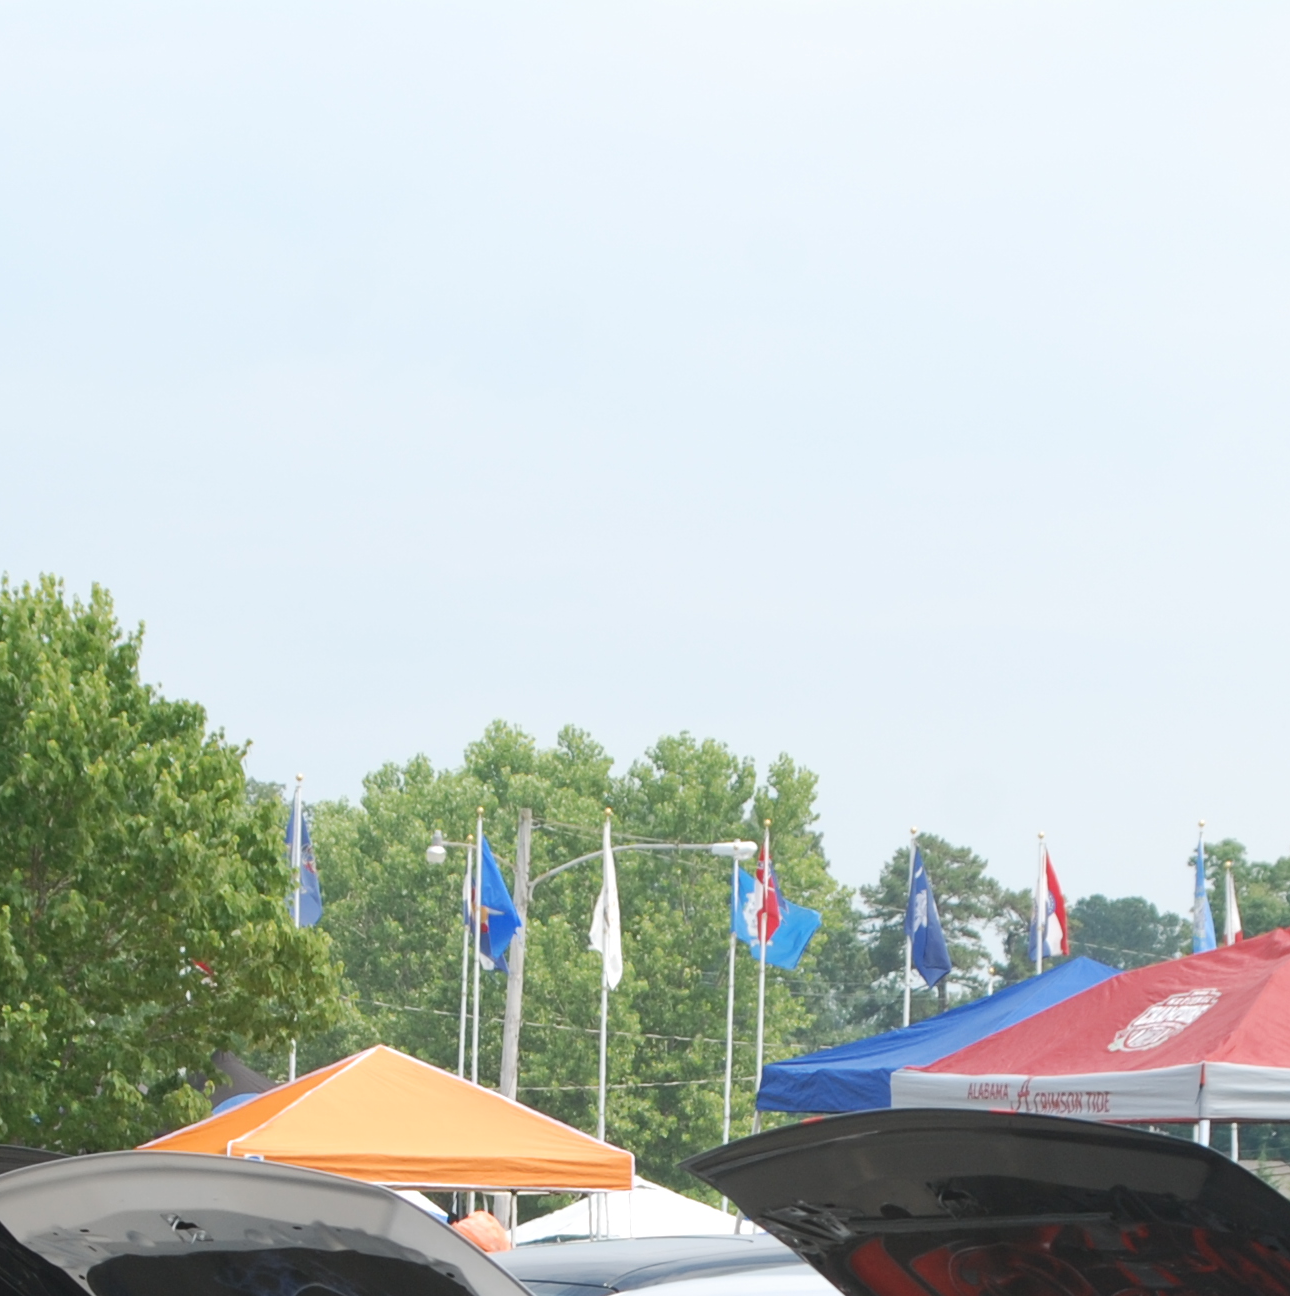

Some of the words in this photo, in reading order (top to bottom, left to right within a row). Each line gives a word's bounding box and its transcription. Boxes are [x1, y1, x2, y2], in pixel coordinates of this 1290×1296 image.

[967, 1082, 1010, 1100] ALABAMA
[1034, 1091, 1083, 1114] CRIMSON
[1086, 1090, 1111, 1113] TIDE
